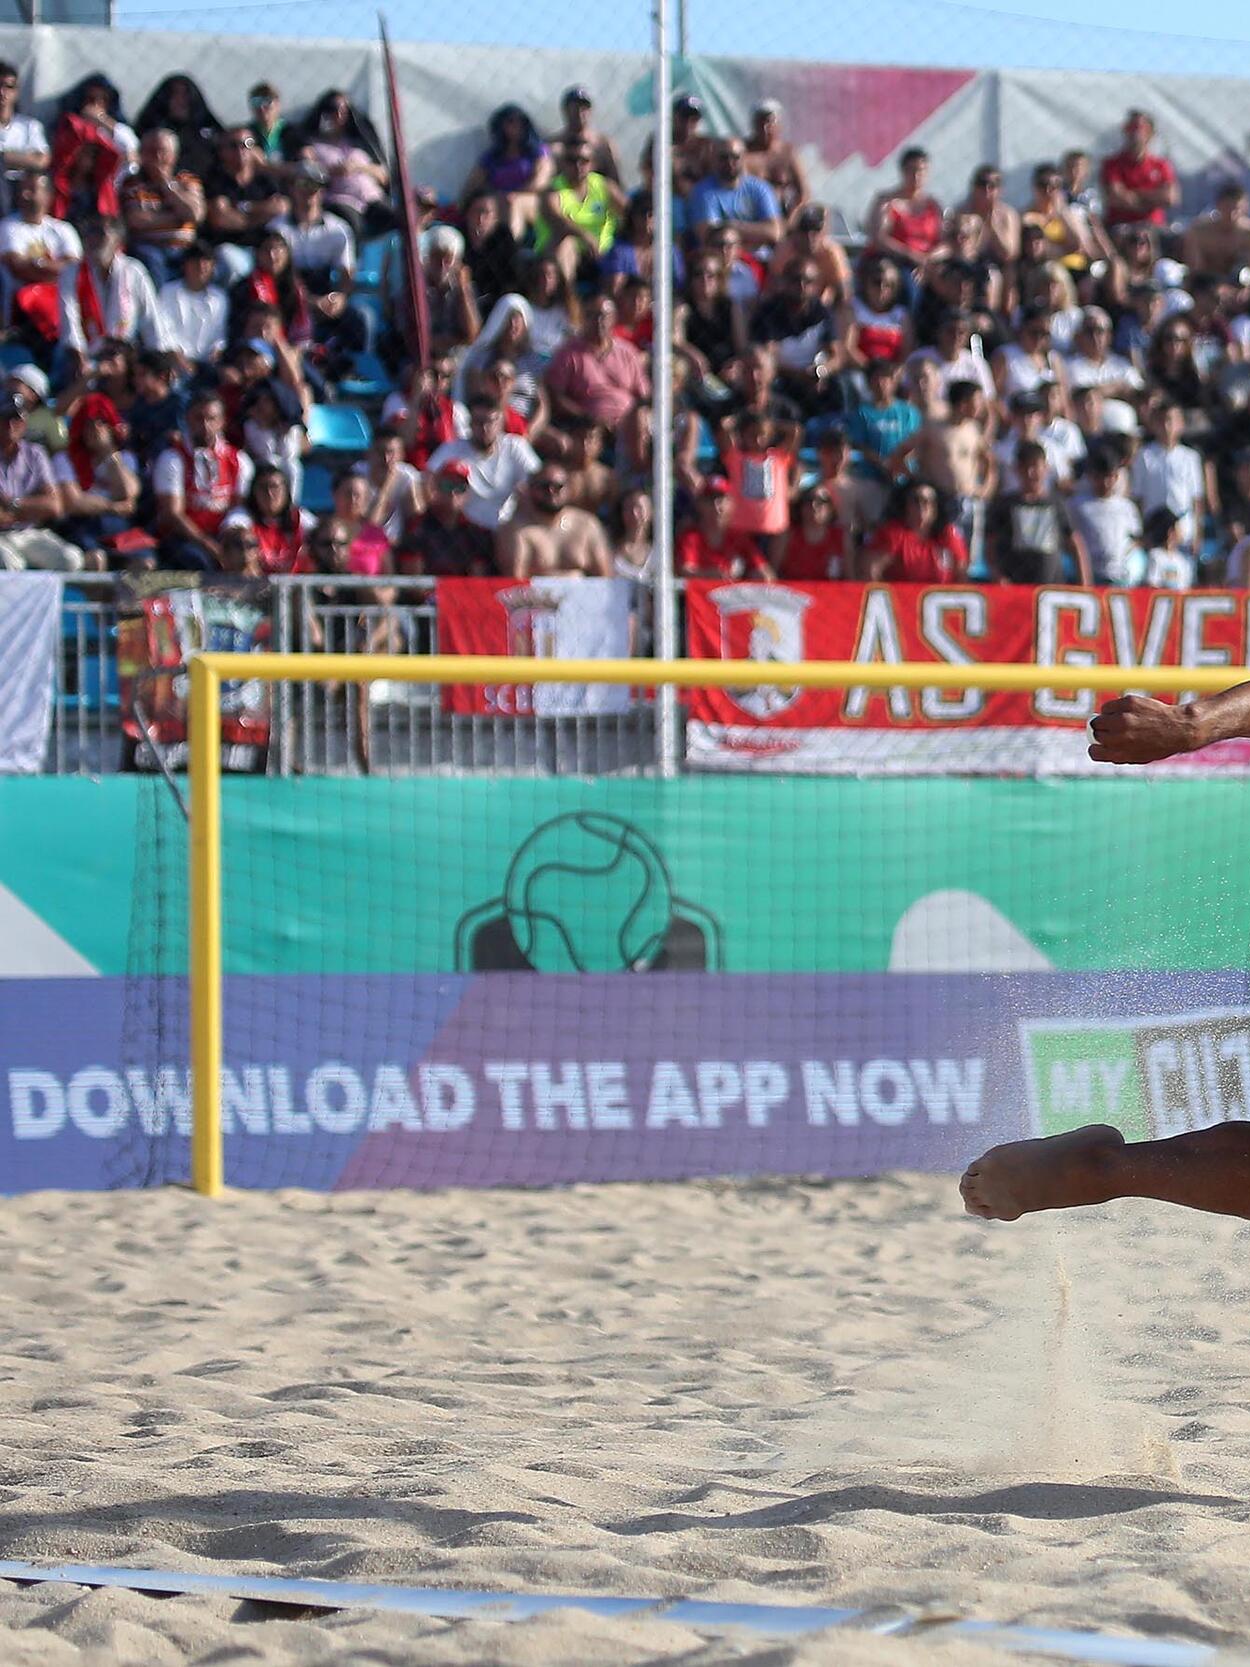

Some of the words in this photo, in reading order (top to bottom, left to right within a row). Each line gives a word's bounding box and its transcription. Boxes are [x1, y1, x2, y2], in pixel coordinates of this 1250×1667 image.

[840, 583, 988, 722] AS
[8, 1063, 477, 1140] DOWNLOAD
[484, 1060, 634, 1131] THE
[645, 1060, 789, 1129] APP
[800, 1057, 985, 1127] NOW
[1050, 1060, 1132, 1115] MY
